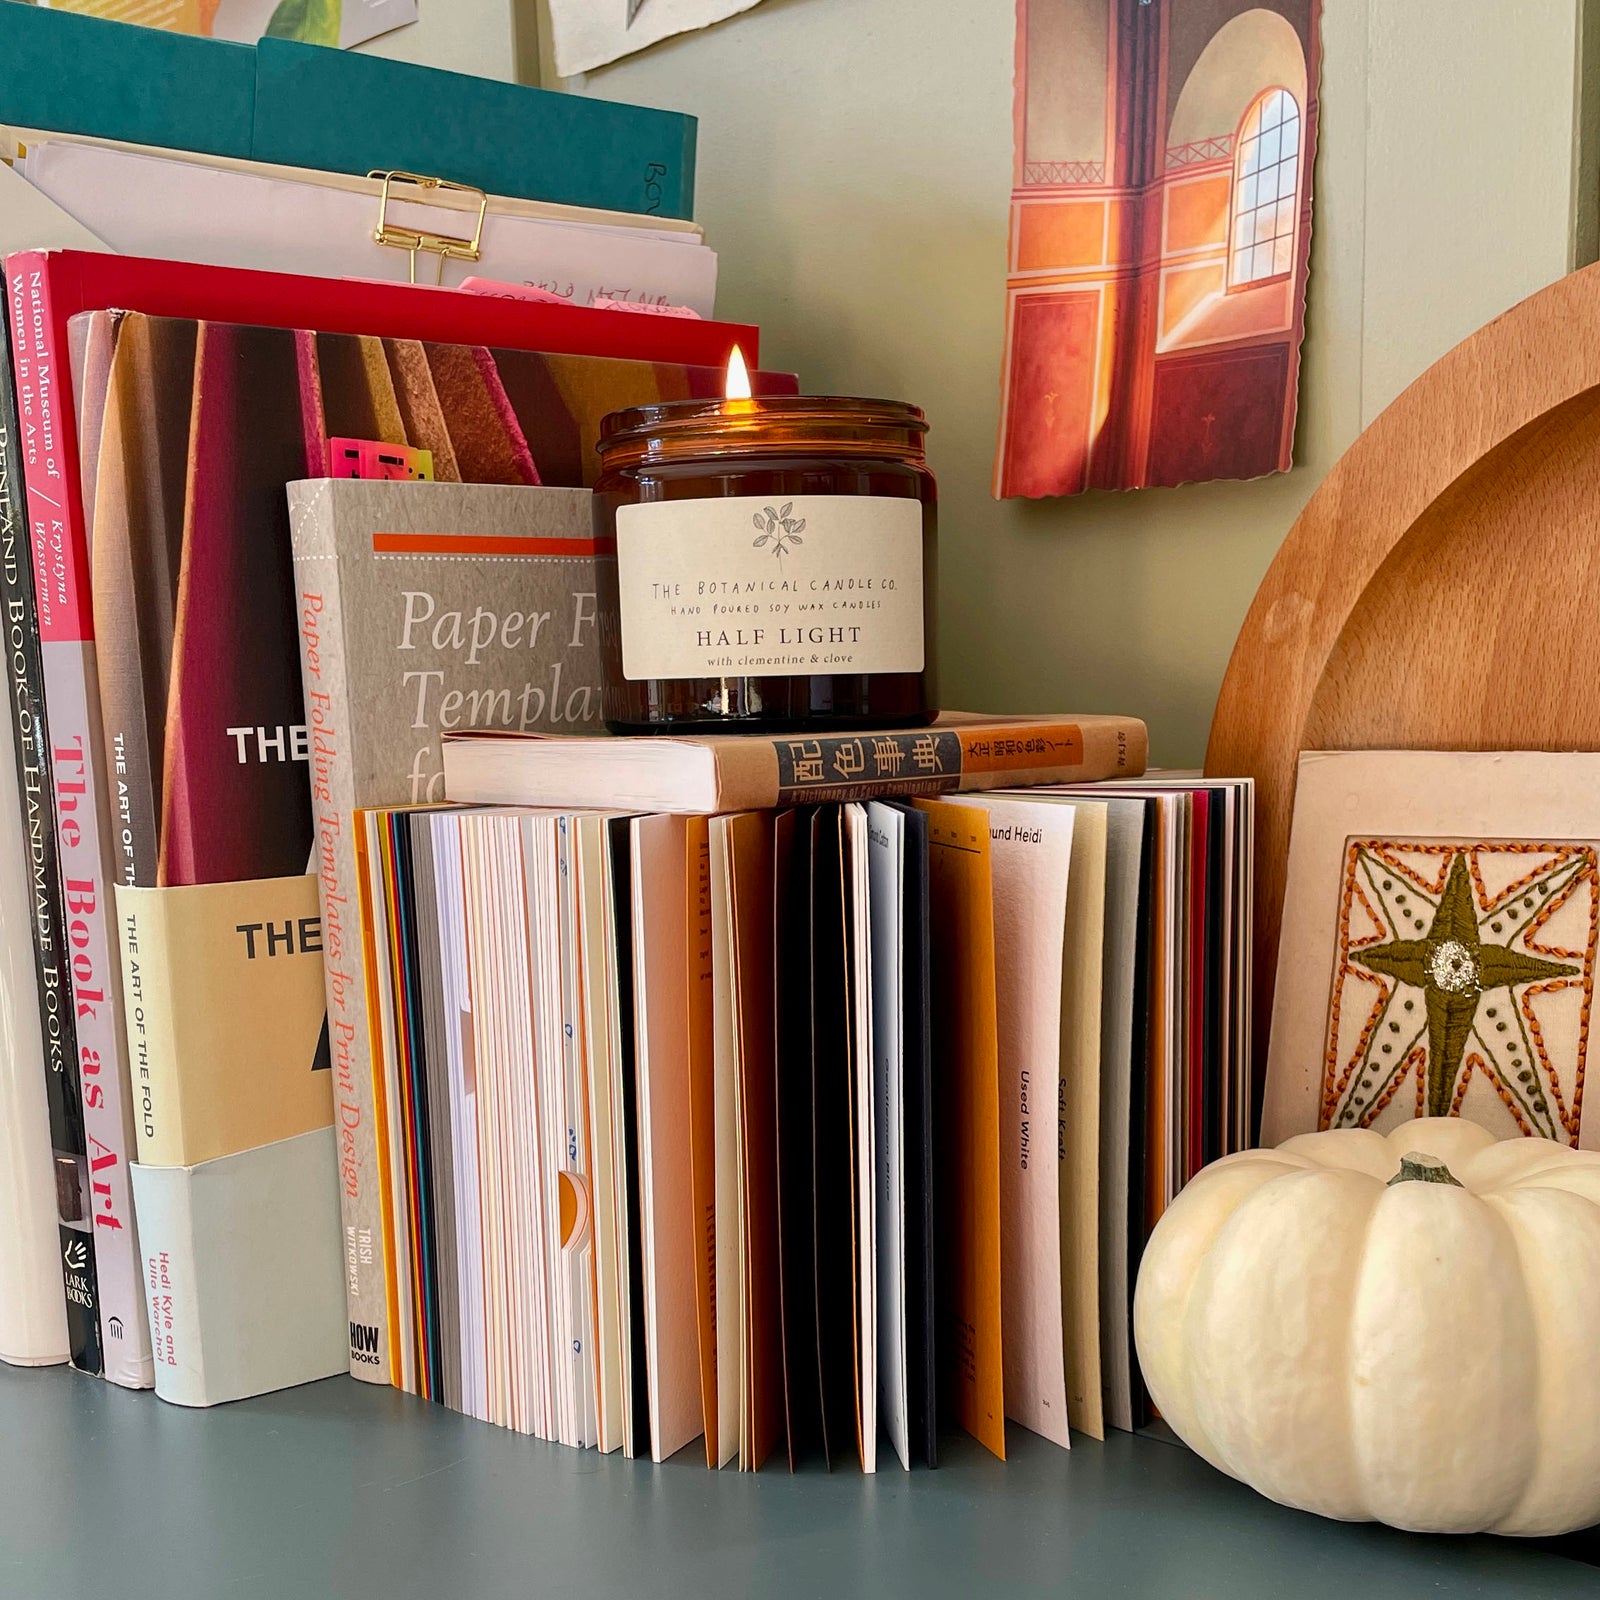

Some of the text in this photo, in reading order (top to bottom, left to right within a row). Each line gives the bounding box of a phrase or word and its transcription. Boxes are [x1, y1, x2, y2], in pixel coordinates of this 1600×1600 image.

[12, 274, 37, 465] Women in the Arts
[30, 271, 60, 479] National Museum of
[35, 521, 51, 626] Wasserman
[50, 520, 67, 604] Krystyna
[652, 578, 897, 599] THE BOTANICAL CANDLE CO.
[397, 591, 550, 665] Paper
[671, 600, 881, 616] HAND POURED SOY WAX CANDLES
[696, 626, 862, 647] HALF LIGHT
[8, 598, 28, 695] BOOK
[707, 652, 853, 666] with clementine & clove
[20, 709, 33, 750] OF
[226, 725, 309, 764] THE
[790, 735, 944, 783] 配色事典
[114, 733, 136, 887] THE ART OF TH
[1015, 826, 1042, 844] Heidi
[25, 766, 52, 952] HANDMADE
[302, 591, 362, 1199] Paper Folding Templates for Print Design
[236, 917, 323, 959] THE
[43, 965, 63, 1073] BOOKS
[54, 736, 123, 1230] The Book as Art
[127, 914, 154, 1138] THE ART OF THE FOLD
[1020, 1070, 1030, 1170] Used White
[65, 1271, 88, 1290] LARK
[347, 1226, 359, 1296] WITKOWSKI
[358, 1228, 372, 1265] TRISH
[66, 1288, 92, 1309] BOOKS
[149, 1258, 163, 1362] Ulla Warchol
[159, 1252, 177, 1366] Hedi Kyle and
[350, 1320, 379, 1354] HOW
[351, 1351, 380, 1365] BOOKS
